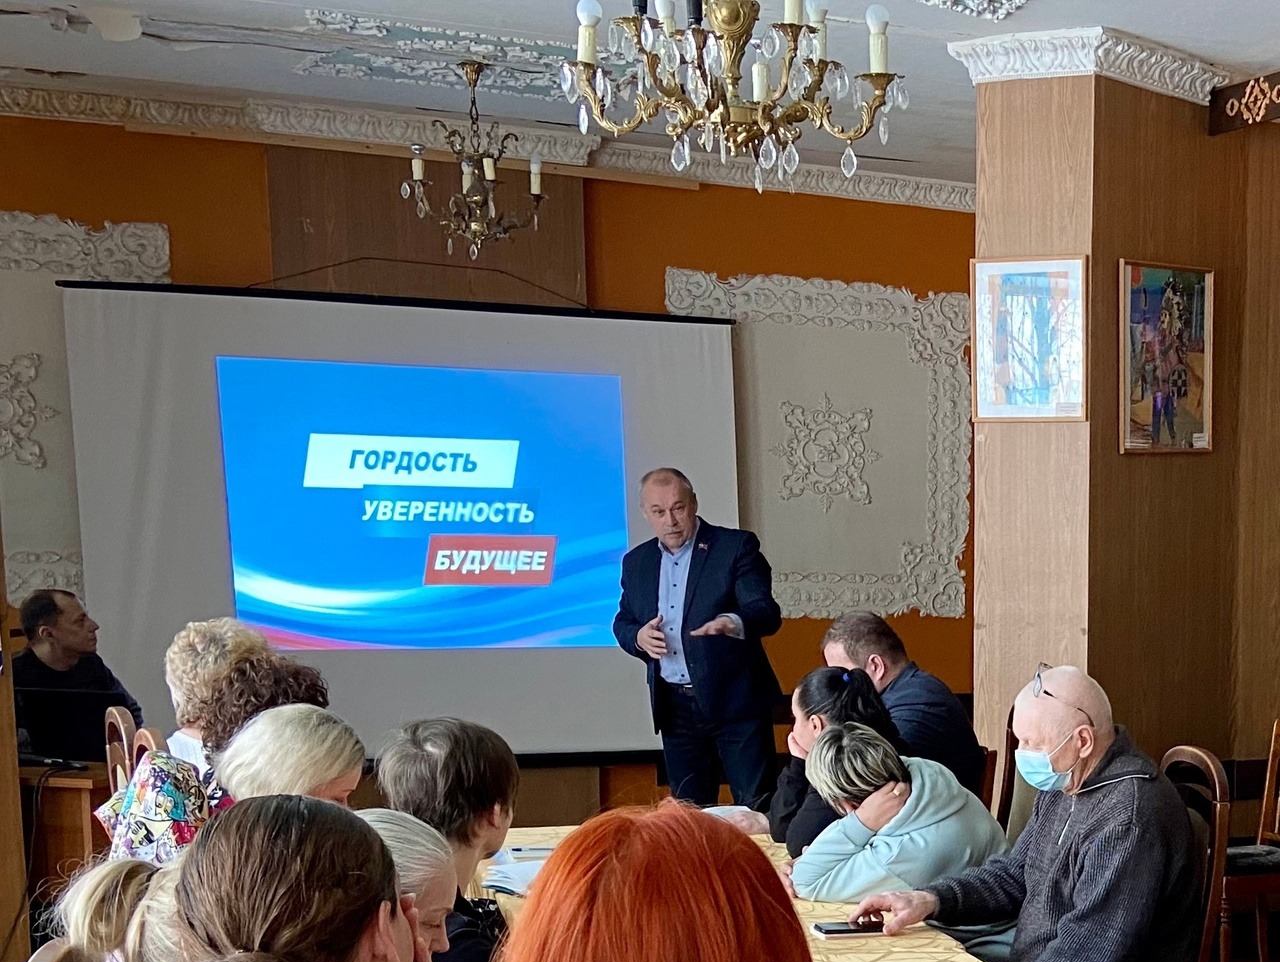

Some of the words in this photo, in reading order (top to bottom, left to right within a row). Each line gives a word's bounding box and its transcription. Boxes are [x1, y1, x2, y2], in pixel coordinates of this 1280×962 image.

[349, 449, 478, 475] ГОРДОСТЬ
[361, 500, 535, 523] УВЕРЕННОСТЬ
[434, 550, 548, 575] БУДУЩЕЕ
